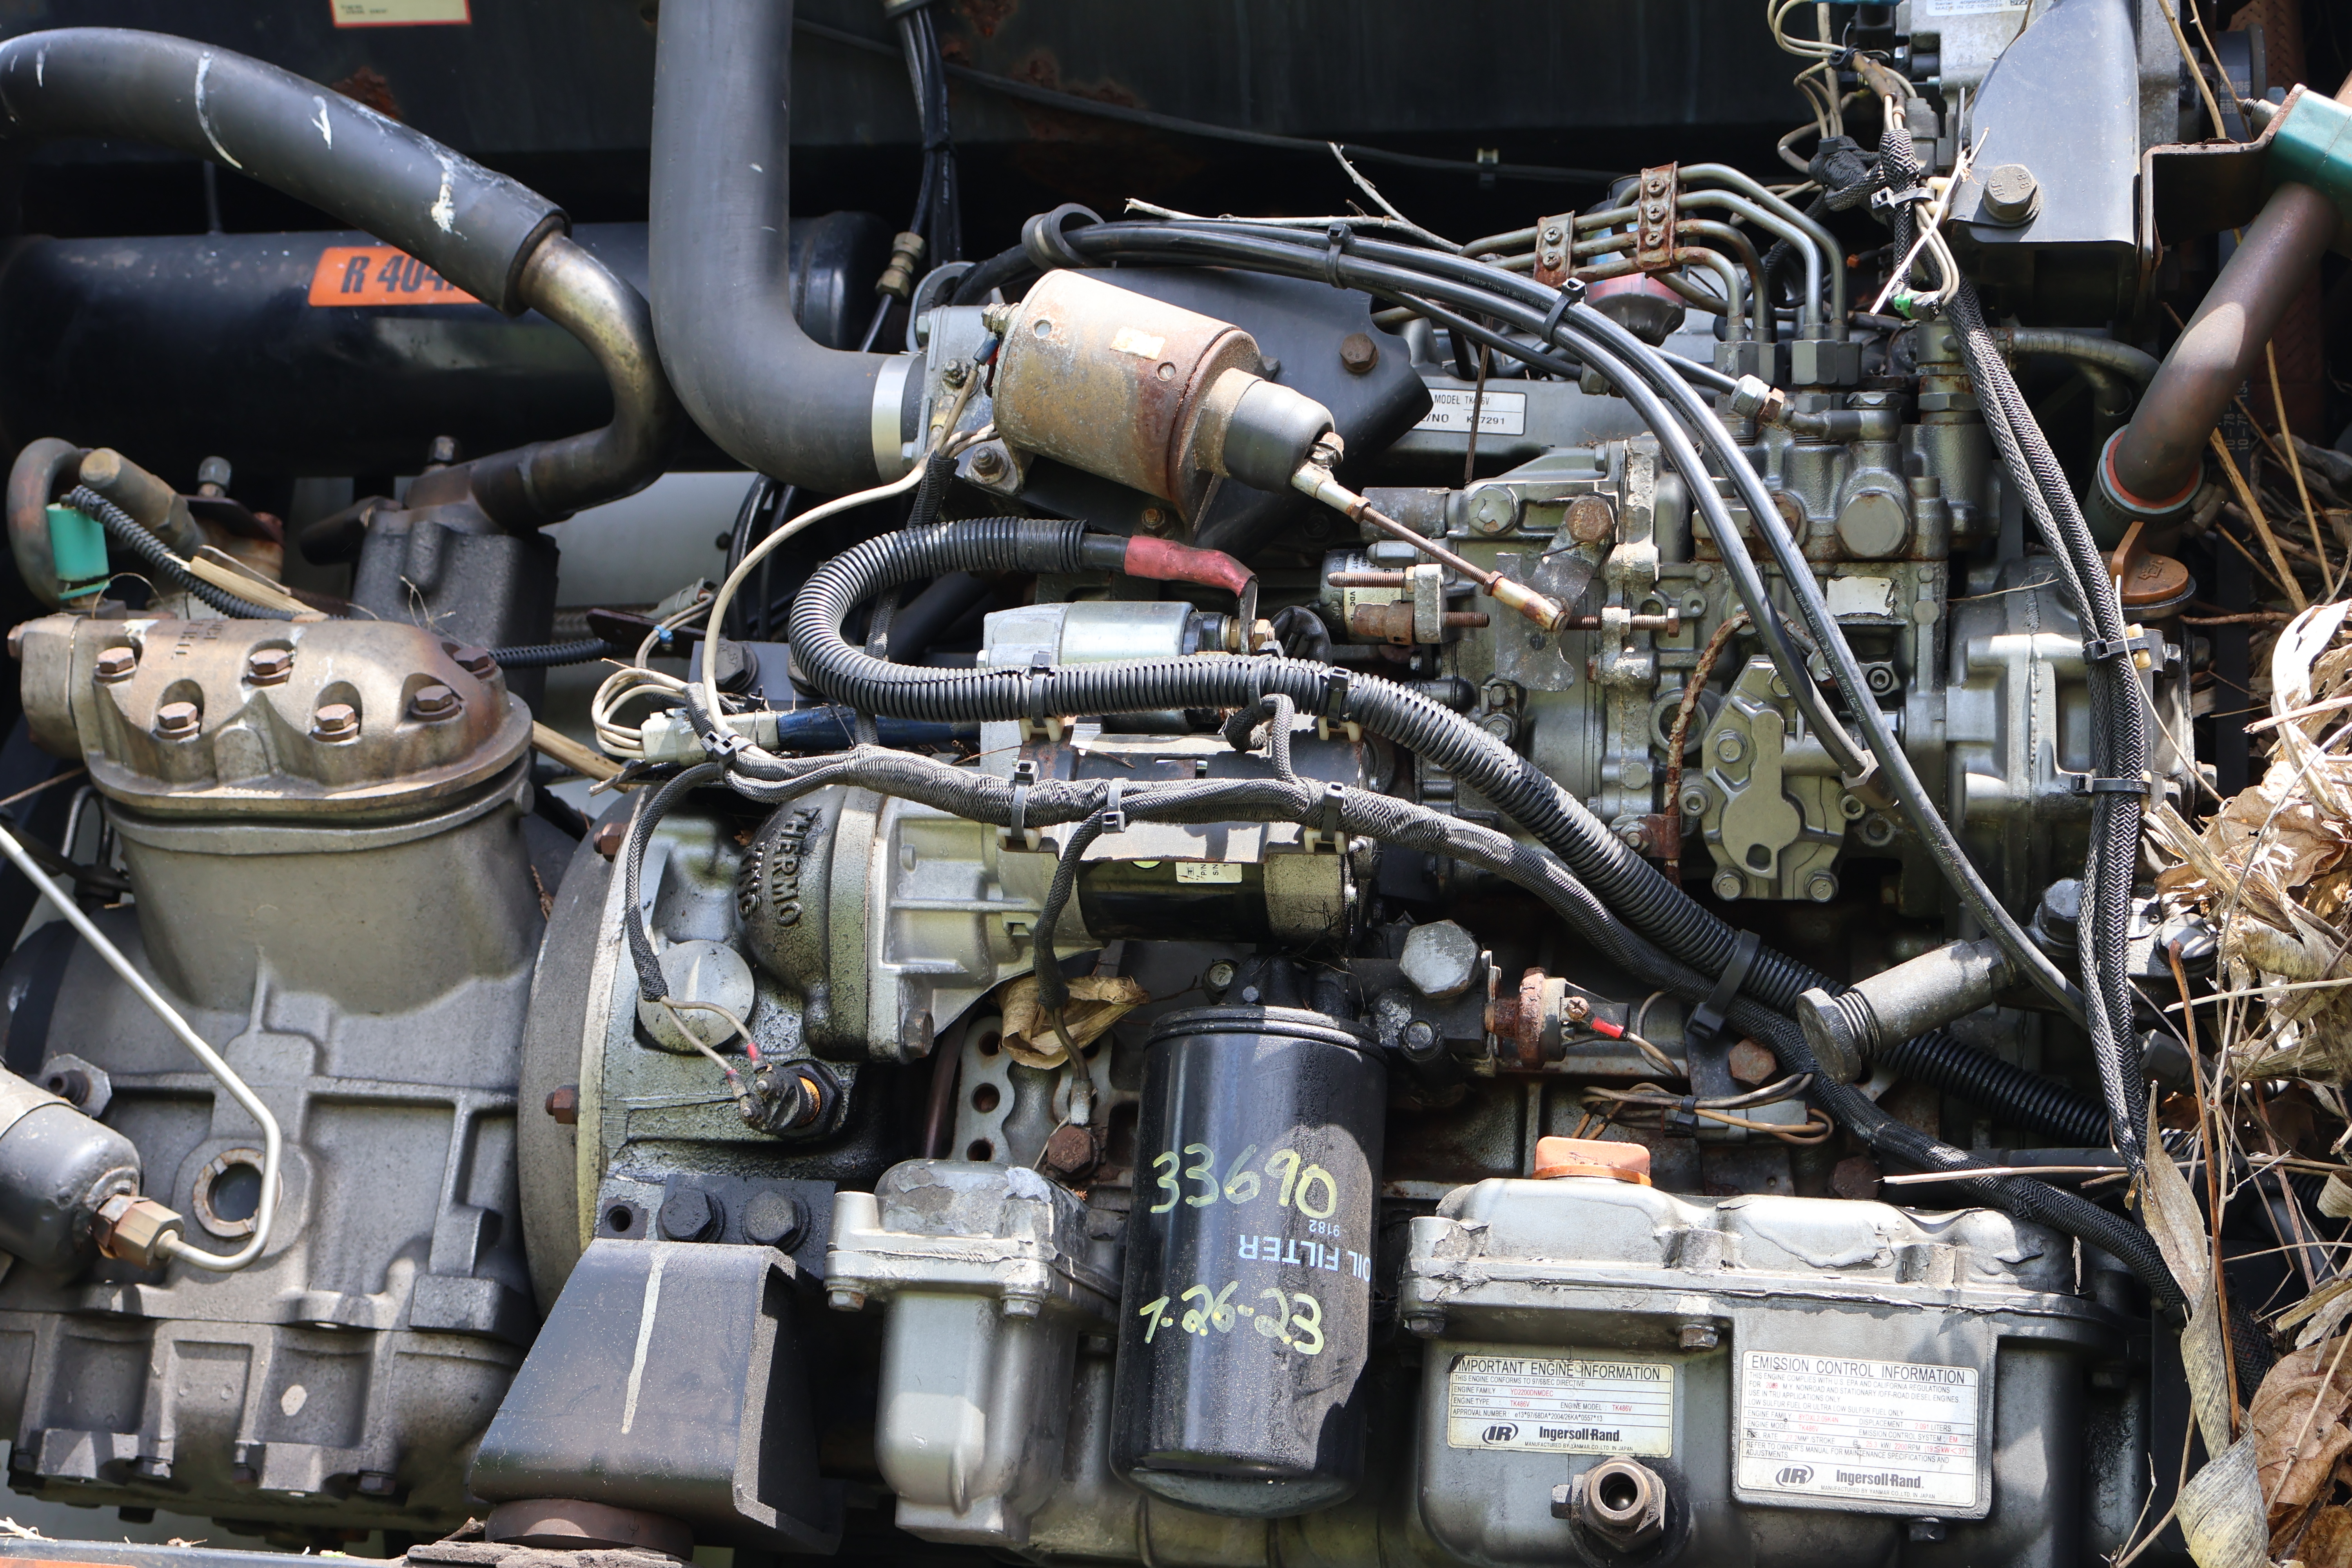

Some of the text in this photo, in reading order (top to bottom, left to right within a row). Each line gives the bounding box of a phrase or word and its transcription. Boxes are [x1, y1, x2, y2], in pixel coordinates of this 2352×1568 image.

[340, 255, 455, 293] R 404
[1434, 394, 1460, 405] MODEL
[1421, 413, 1505, 425] /NO K7291
[771, 808, 822, 927] THERMO
[1150, 1143, 1338, 1219] 33690
[1309, 1219, 1340, 1237] 9182
[1238, 1234, 1371, 1283] OIL FILTER
[1458, 1358, 1660, 1381] IMPORTANT ENGINE INFORMATION
[1752, 1355, 1965, 1384] EMISSION CONTROL INFORMATION
[1787, 1375, 1816, 1383] COMPLIES
[1873, 1381, 1907, 1390] CALIFORNIA
[1909, 1384, 1950, 1393] REGULATIONS
[1510, 1388, 1553, 1397] YD2200DNMDEC
[1782, 1392, 1824, 1401] APPLICATIONS
[1840, 1388, 1876, 1396] STATIONARY
[1878, 1390, 1909, 1399] /OFF-ROAD
[1933, 1395, 1961, 1403] ENGINES.
[1847, 1406, 1870, 1414] SULFUR
[1771, 1411, 1792, 1419] FAMILY
[1798, 1414, 1838, 1423] 8YDXL2.09K4N
[1859, 1418, 1903, 1428] DISPLACEMENT
[1888, 1431, 1916, 1439] CONTROL
[1746, 1449, 1789, 1458] ADJUSTMENTS.
[1844, 1449, 1886, 1458] MAINTENANCE
[1887, 1453, 1935, 1462] SPECIFICATIONS
